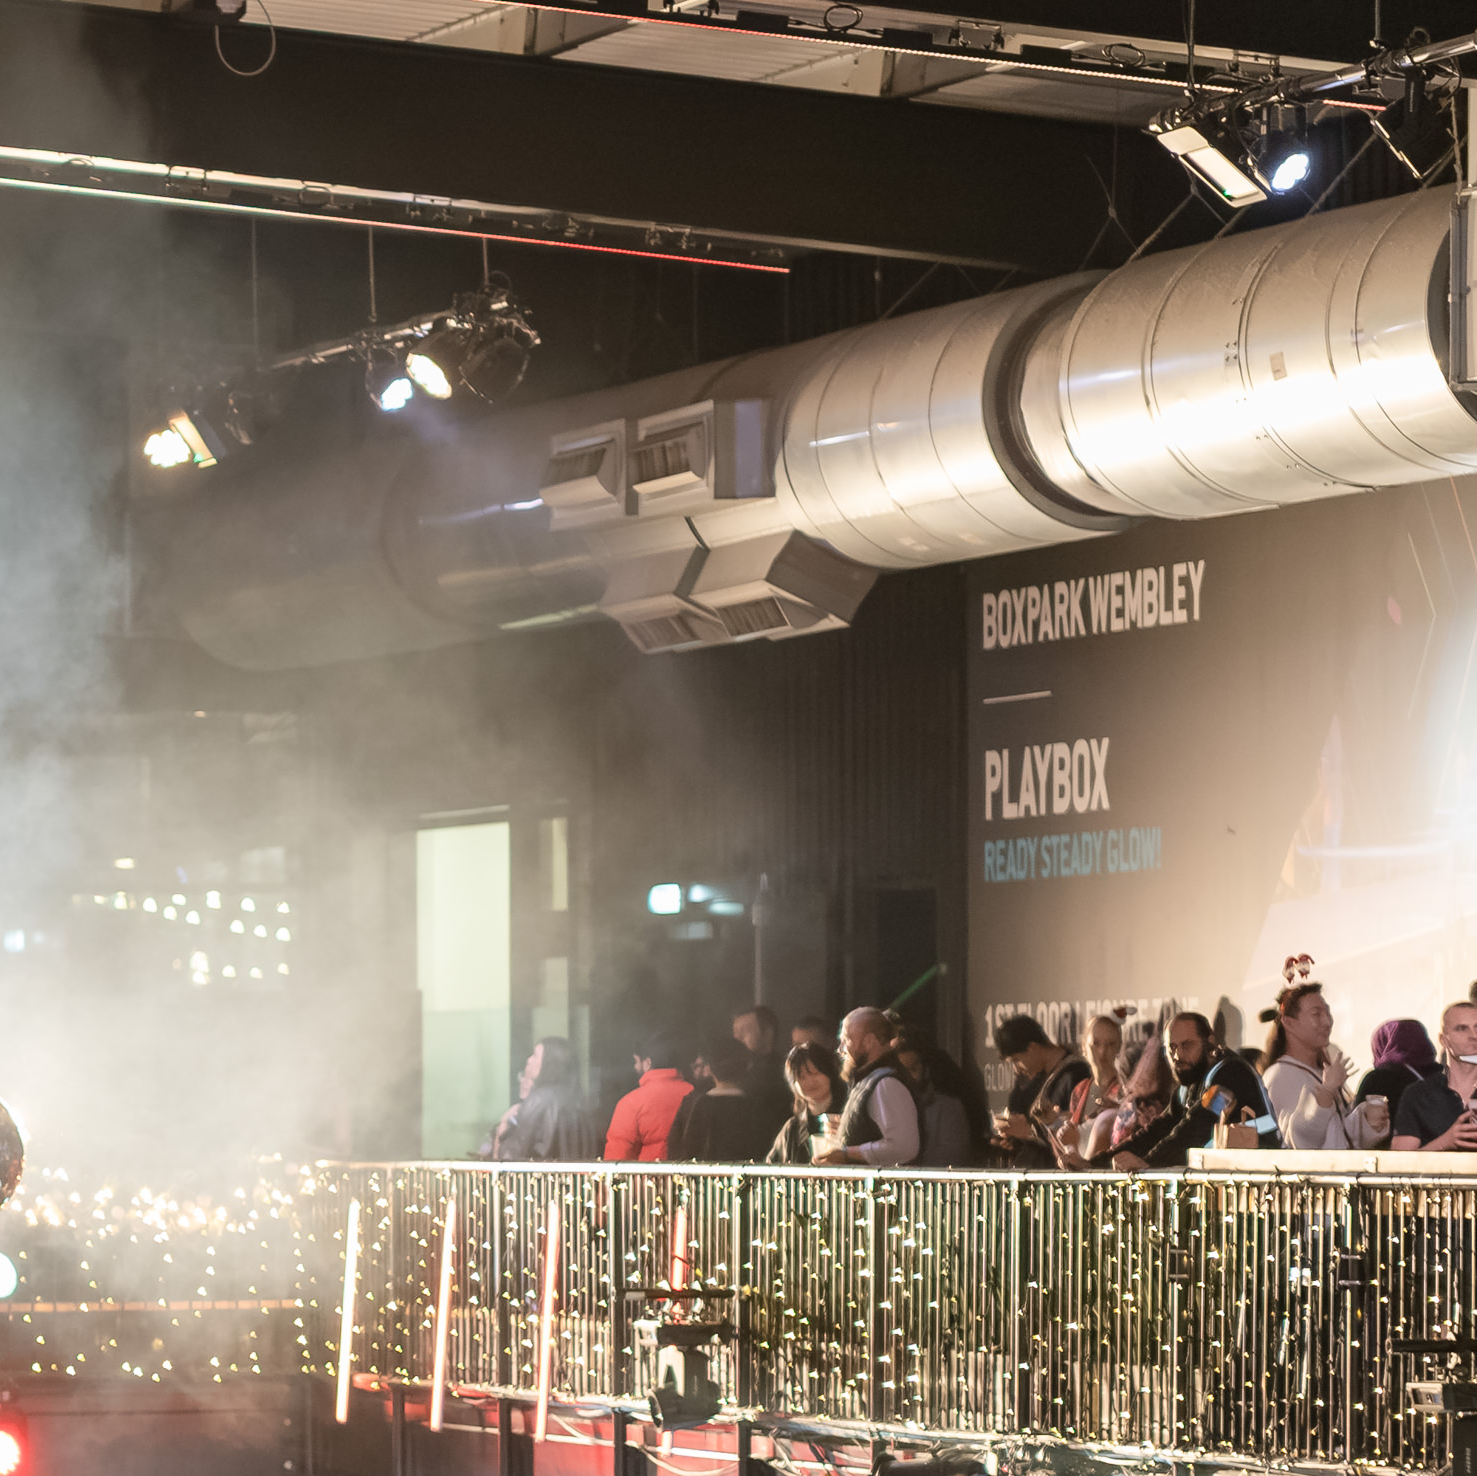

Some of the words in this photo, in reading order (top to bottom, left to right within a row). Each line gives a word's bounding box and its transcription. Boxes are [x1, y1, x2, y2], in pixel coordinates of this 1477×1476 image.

[983, 578, 1086, 650] BOXPARK
[1089, 560, 1205, 634] WEMBLEY
[985, 737, 1110, 821] PLAYBOX
[984, 836, 1037, 882] READY
[1041, 831, 1103, 879] STEADY
[1106, 826, 1161, 873] GLOW!
